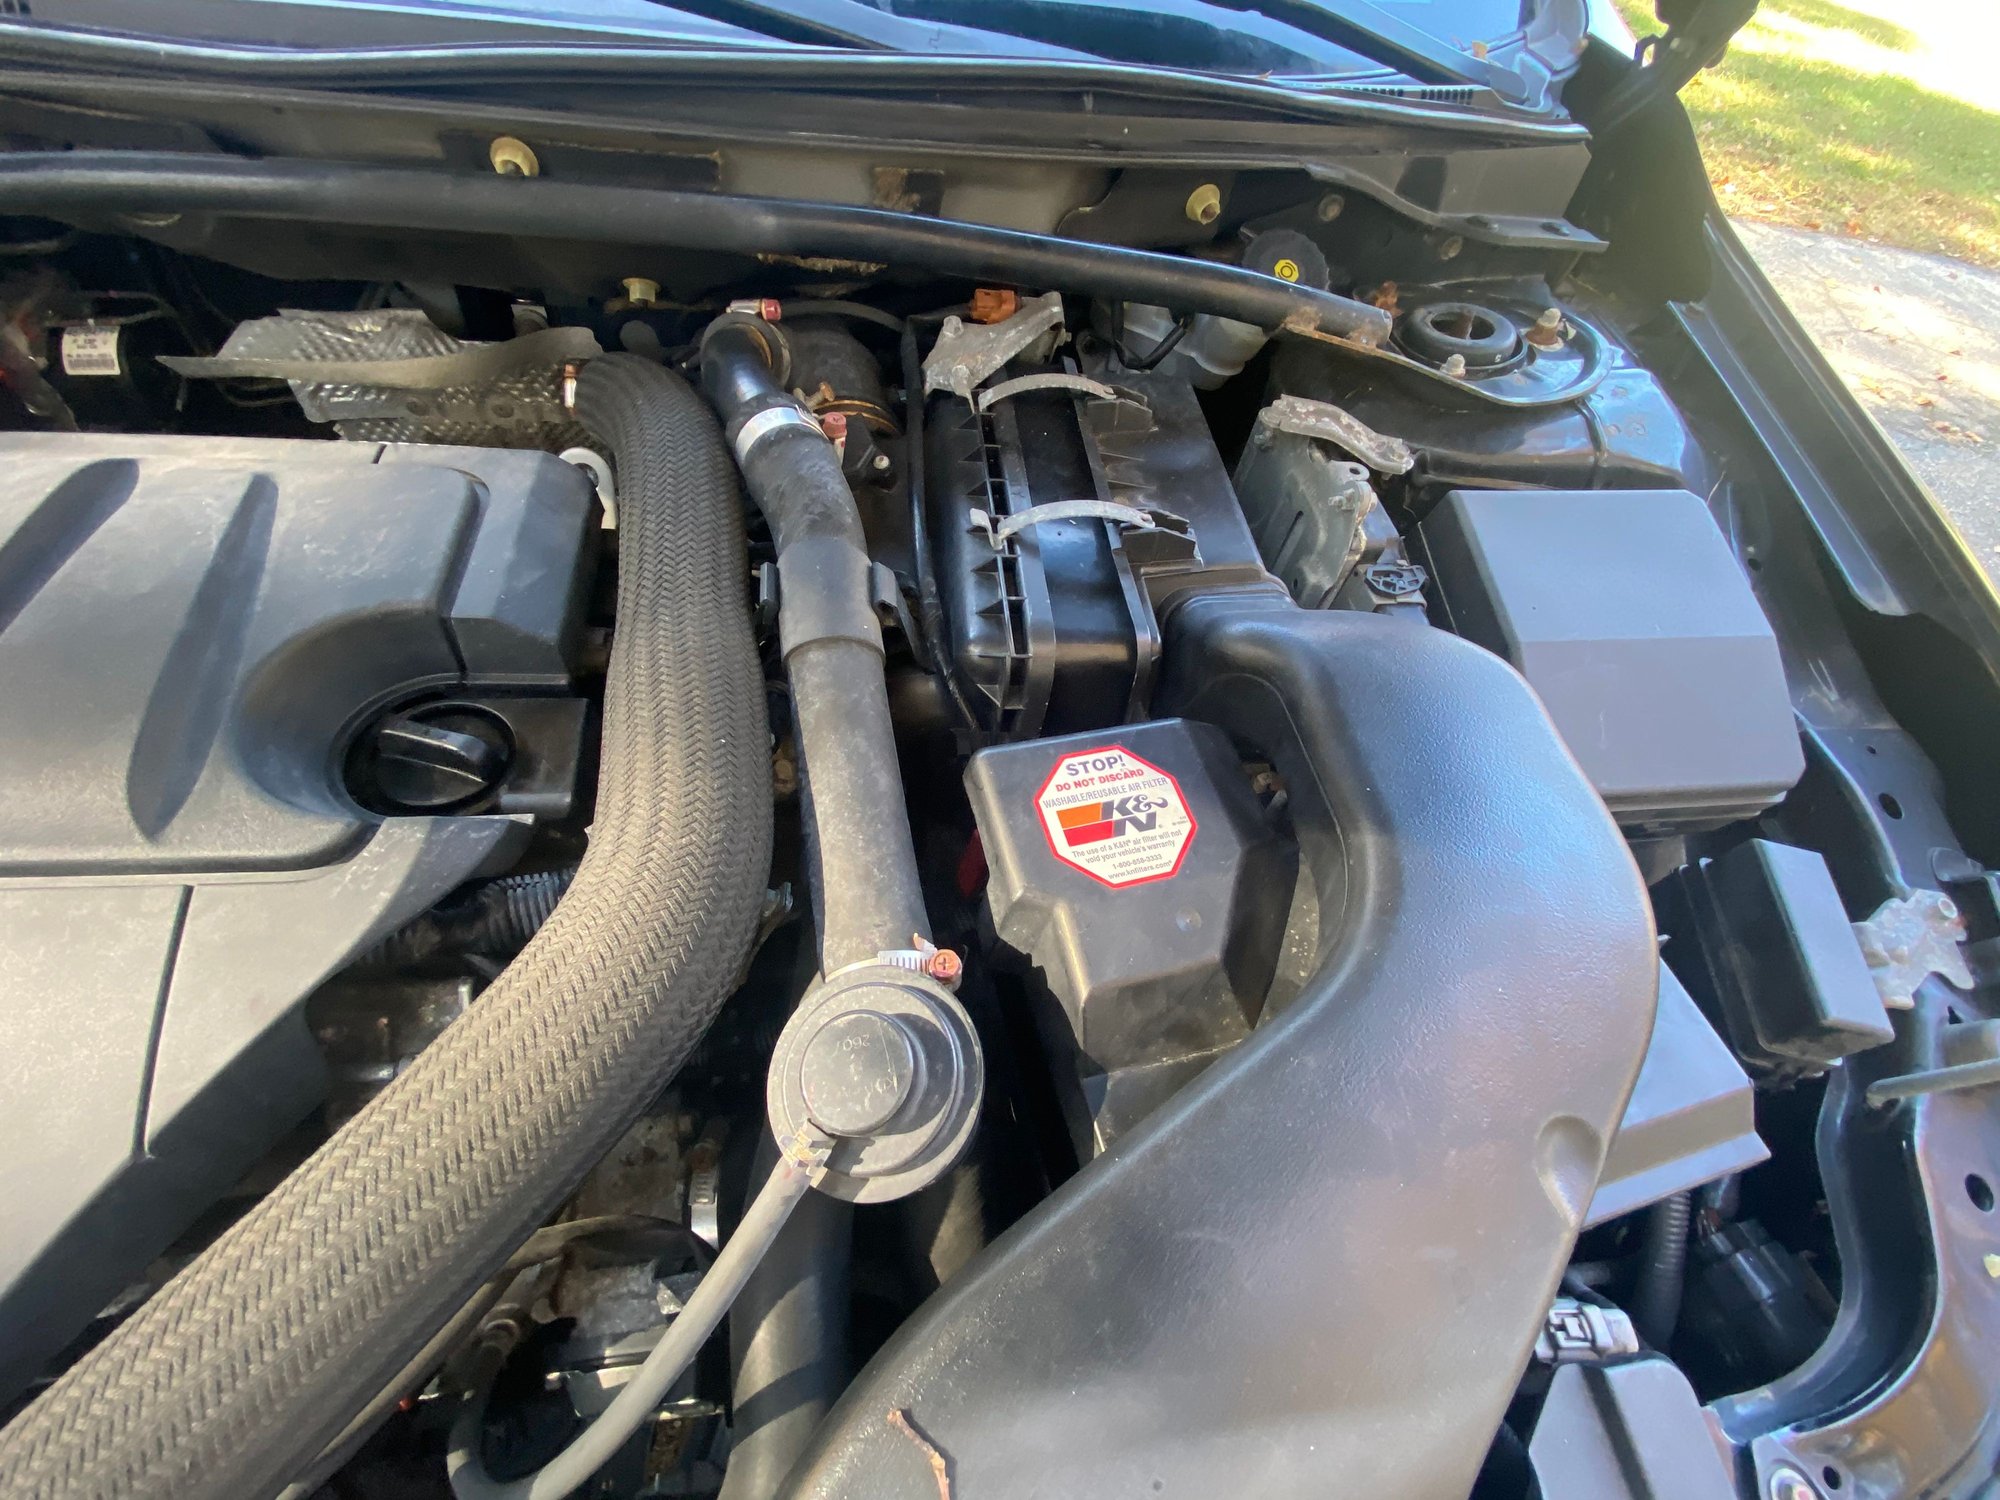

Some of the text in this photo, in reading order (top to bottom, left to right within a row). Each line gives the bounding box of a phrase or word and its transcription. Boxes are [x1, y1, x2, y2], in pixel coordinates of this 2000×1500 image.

[1065, 754, 1126, 776] STOP!
[1043, 776, 1168, 809] WASHABLE/REUSABLE AIR FILTER
[1056, 768, 1144, 792] DO NOT DISCARD
[1072, 850, 1085, 858] The
[1086, 847, 1099, 855] use
[1100, 844, 1107, 853] of
[1133, 838, 1141, 846] air
[1142, 834, 1157, 843] filter
[1158, 831, 1170, 840] will
[1171, 829, 1182, 838] not
[1085, 855, 1100, 864] void
[1101, 852, 1116, 862] your
[1147, 839, 1175, 851] warranty
